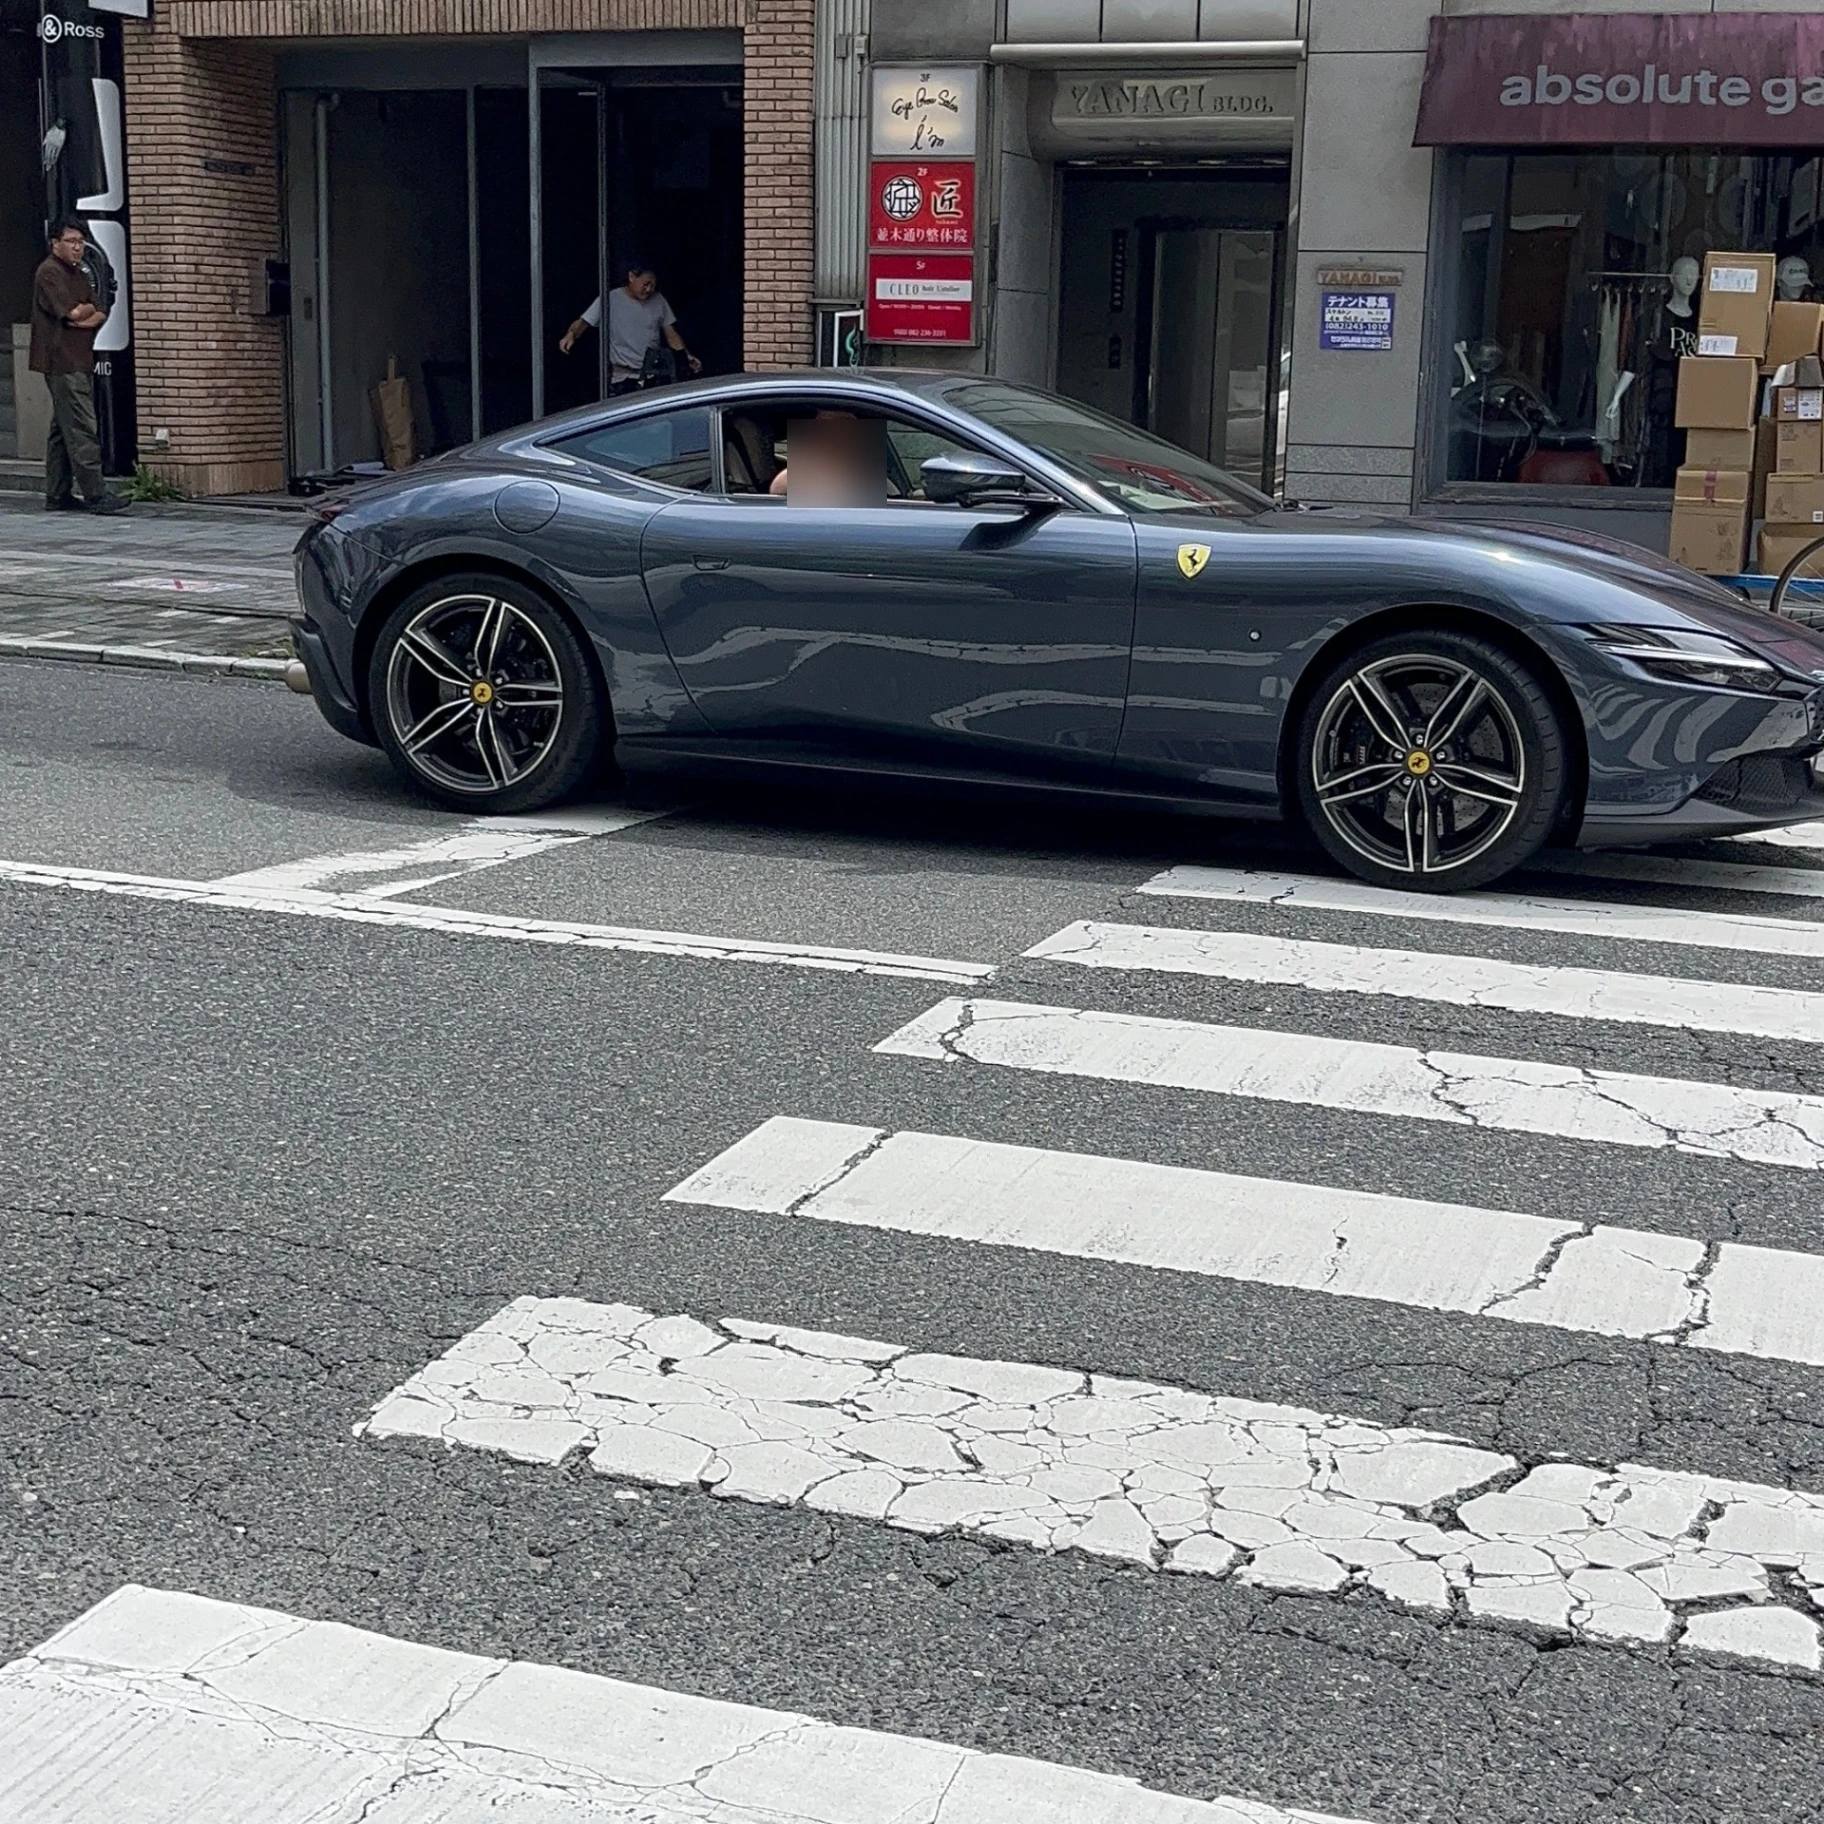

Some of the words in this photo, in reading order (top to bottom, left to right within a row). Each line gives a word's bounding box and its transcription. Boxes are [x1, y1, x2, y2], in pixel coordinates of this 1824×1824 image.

[64, 21, 104, 38] Ross
[919, 73, 931, 82] 3F
[1500, 64, 1751, 106] absolute
[1072, 84, 1205, 113] YANAGI
[1213, 95, 1274, 113] BLDG.
[931, 179, 963, 218] 匠
[877, 227, 968, 243] 並木通り整体院
[889, 283, 920, 296] CLEO
[1670, 327, 1697, 351] PR
